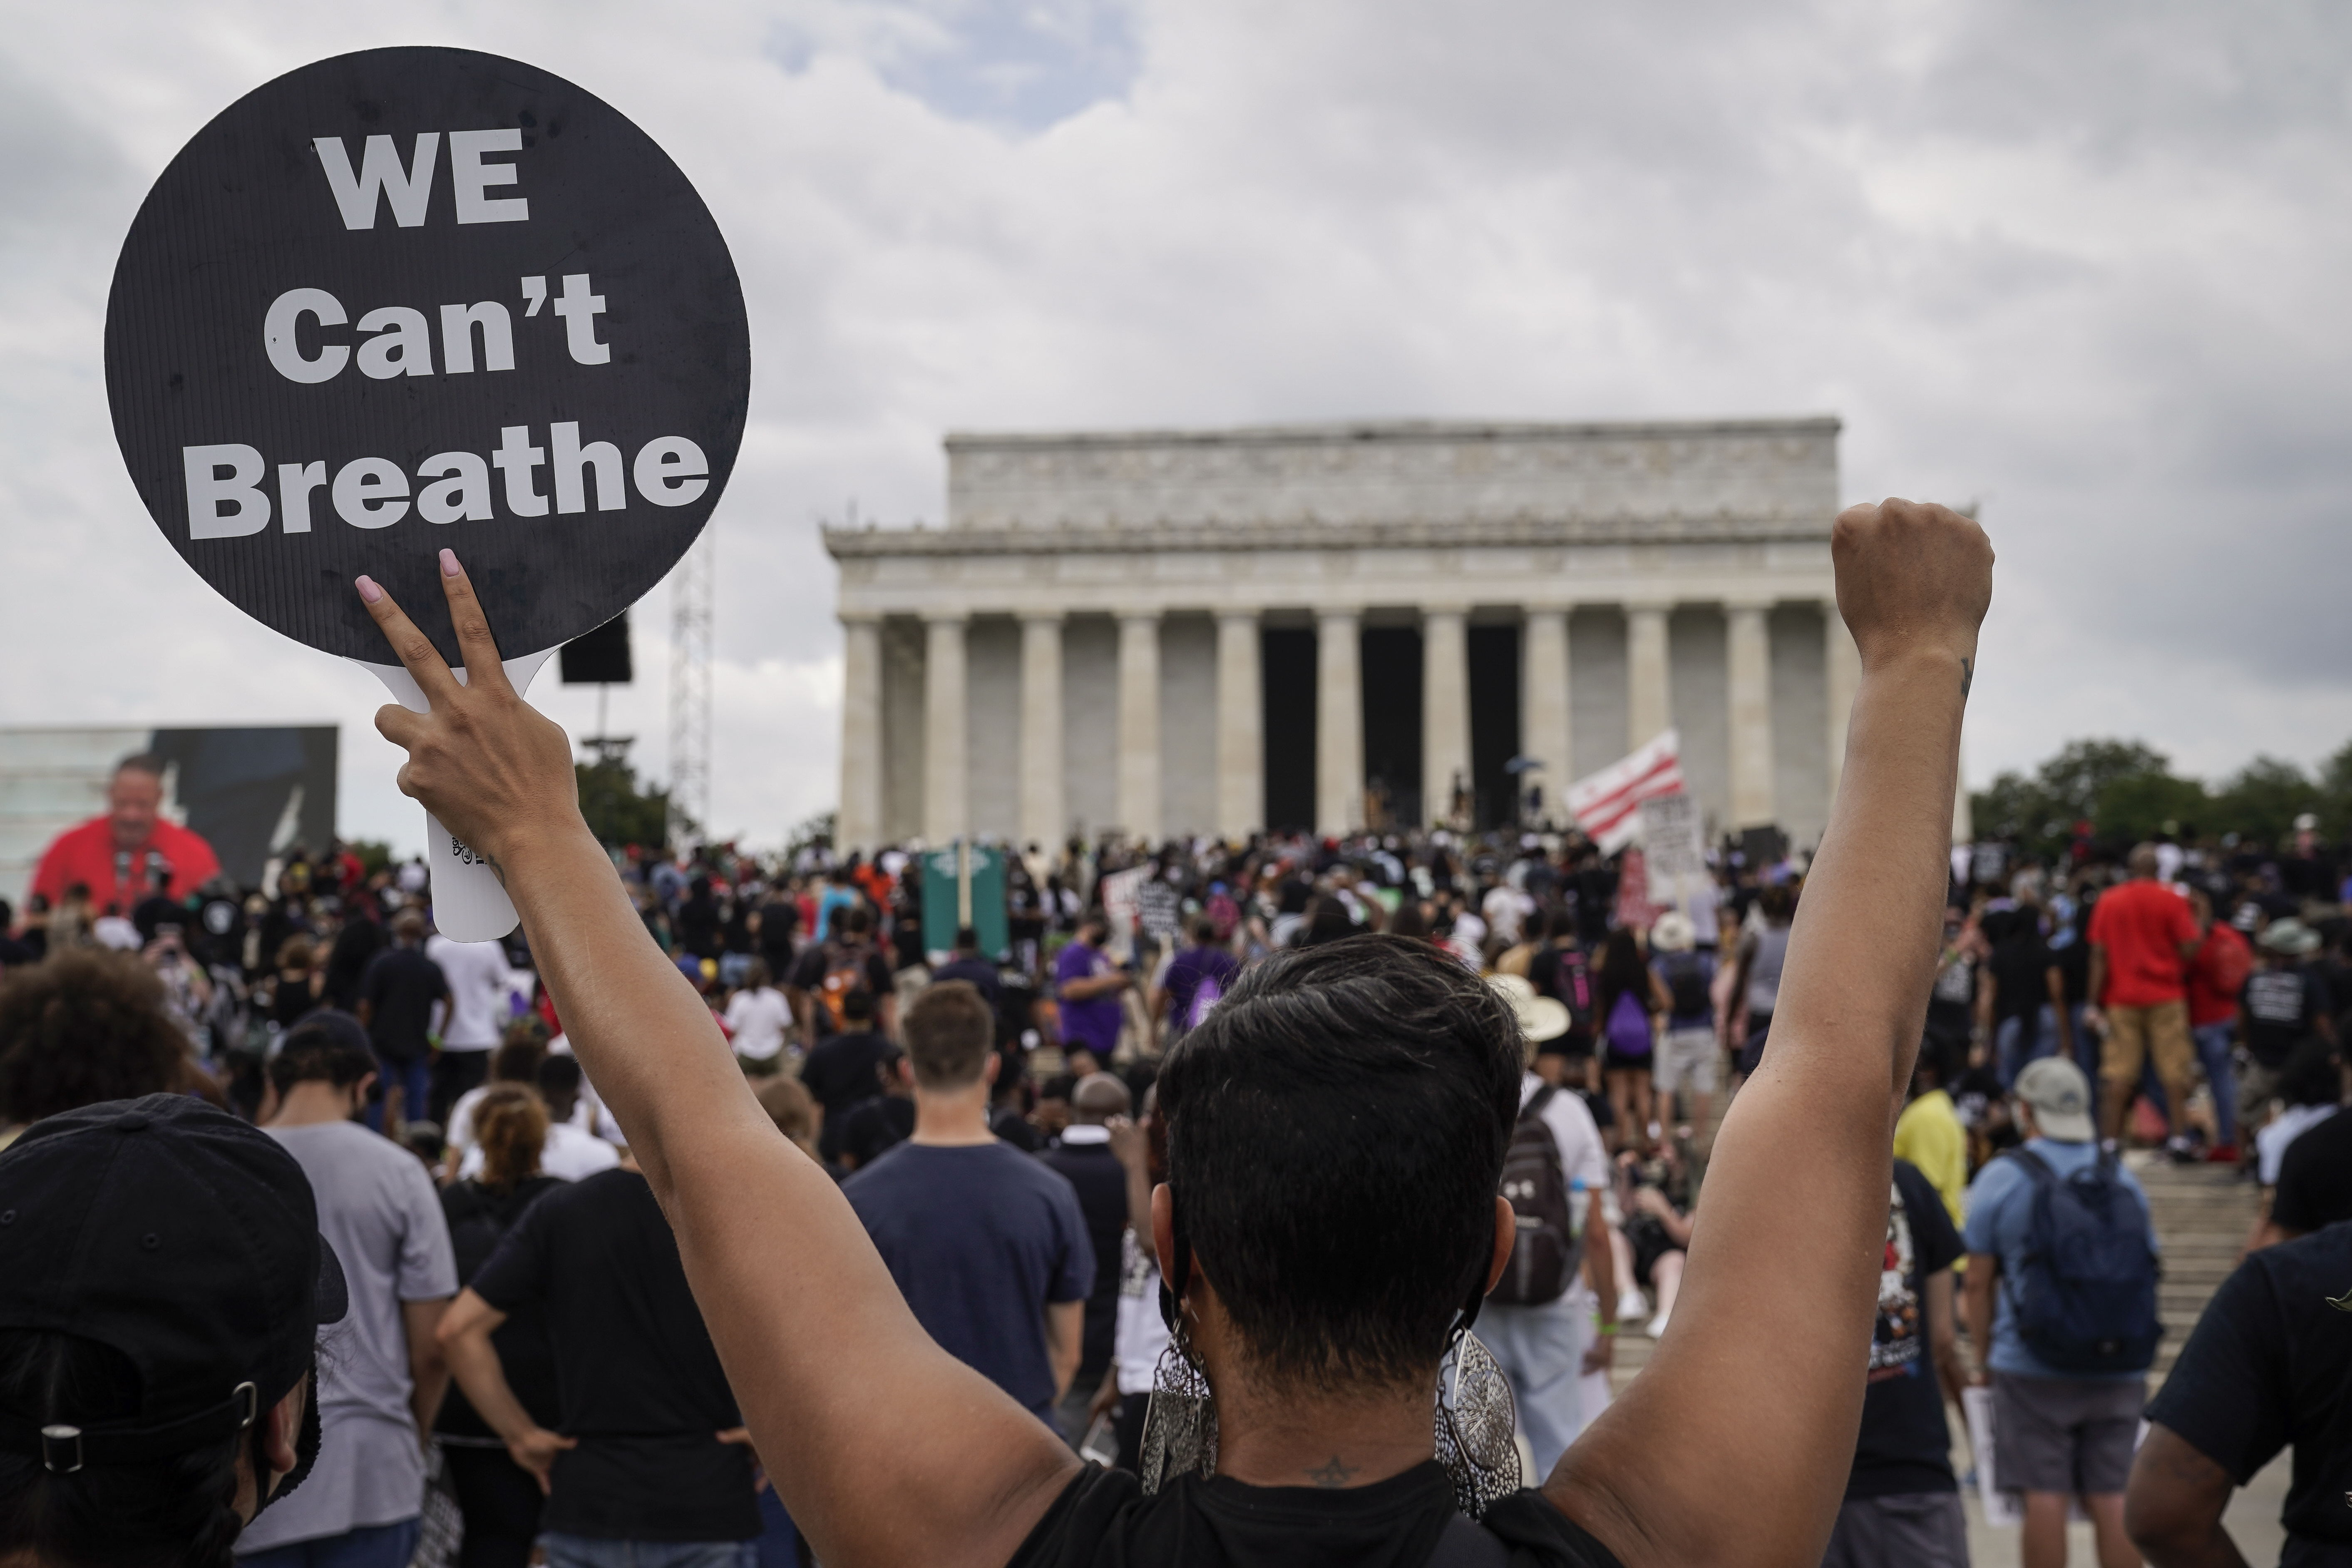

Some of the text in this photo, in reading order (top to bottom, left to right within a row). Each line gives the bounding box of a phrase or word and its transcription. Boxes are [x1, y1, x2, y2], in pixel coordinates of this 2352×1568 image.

[313, 129, 529, 230] WE
[264, 273, 610, 383] Can’t
[183, 421, 709, 539] Breathe
